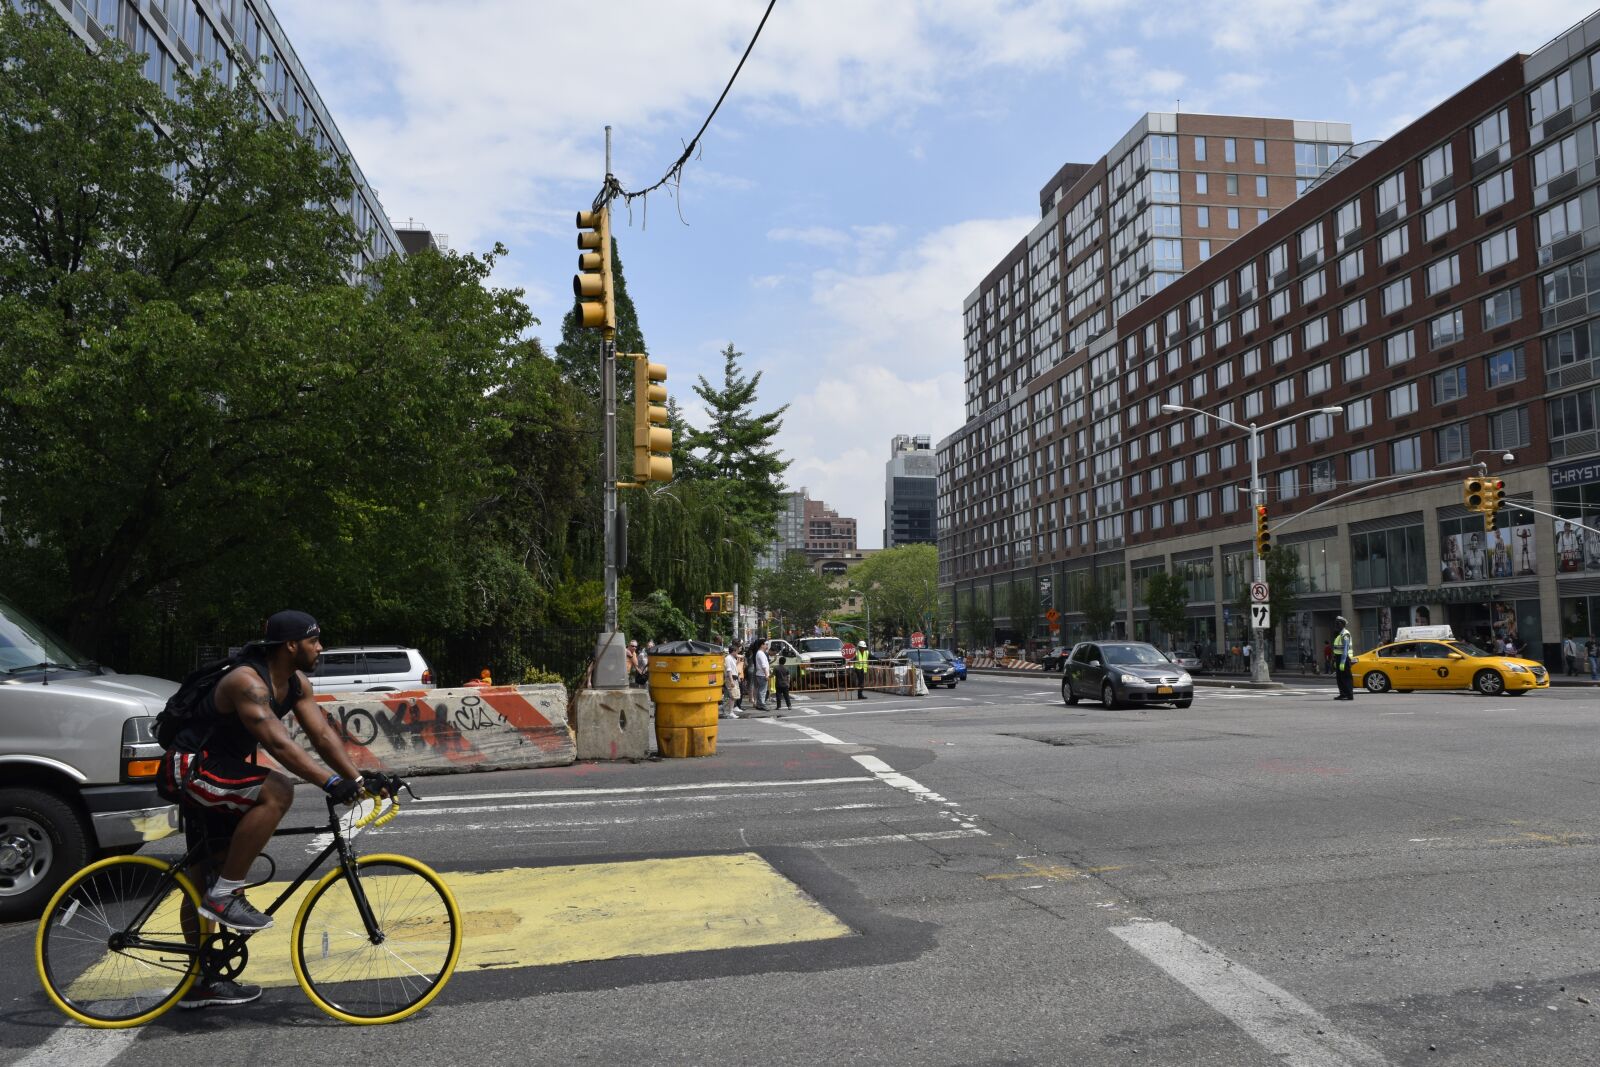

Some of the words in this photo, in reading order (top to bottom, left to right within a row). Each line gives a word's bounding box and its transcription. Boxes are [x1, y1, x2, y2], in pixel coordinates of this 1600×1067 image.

[1551, 465, 1600, 484] CHRYST
[841, 647, 856, 655] STOP
[1440, 668, 1447, 676] T
